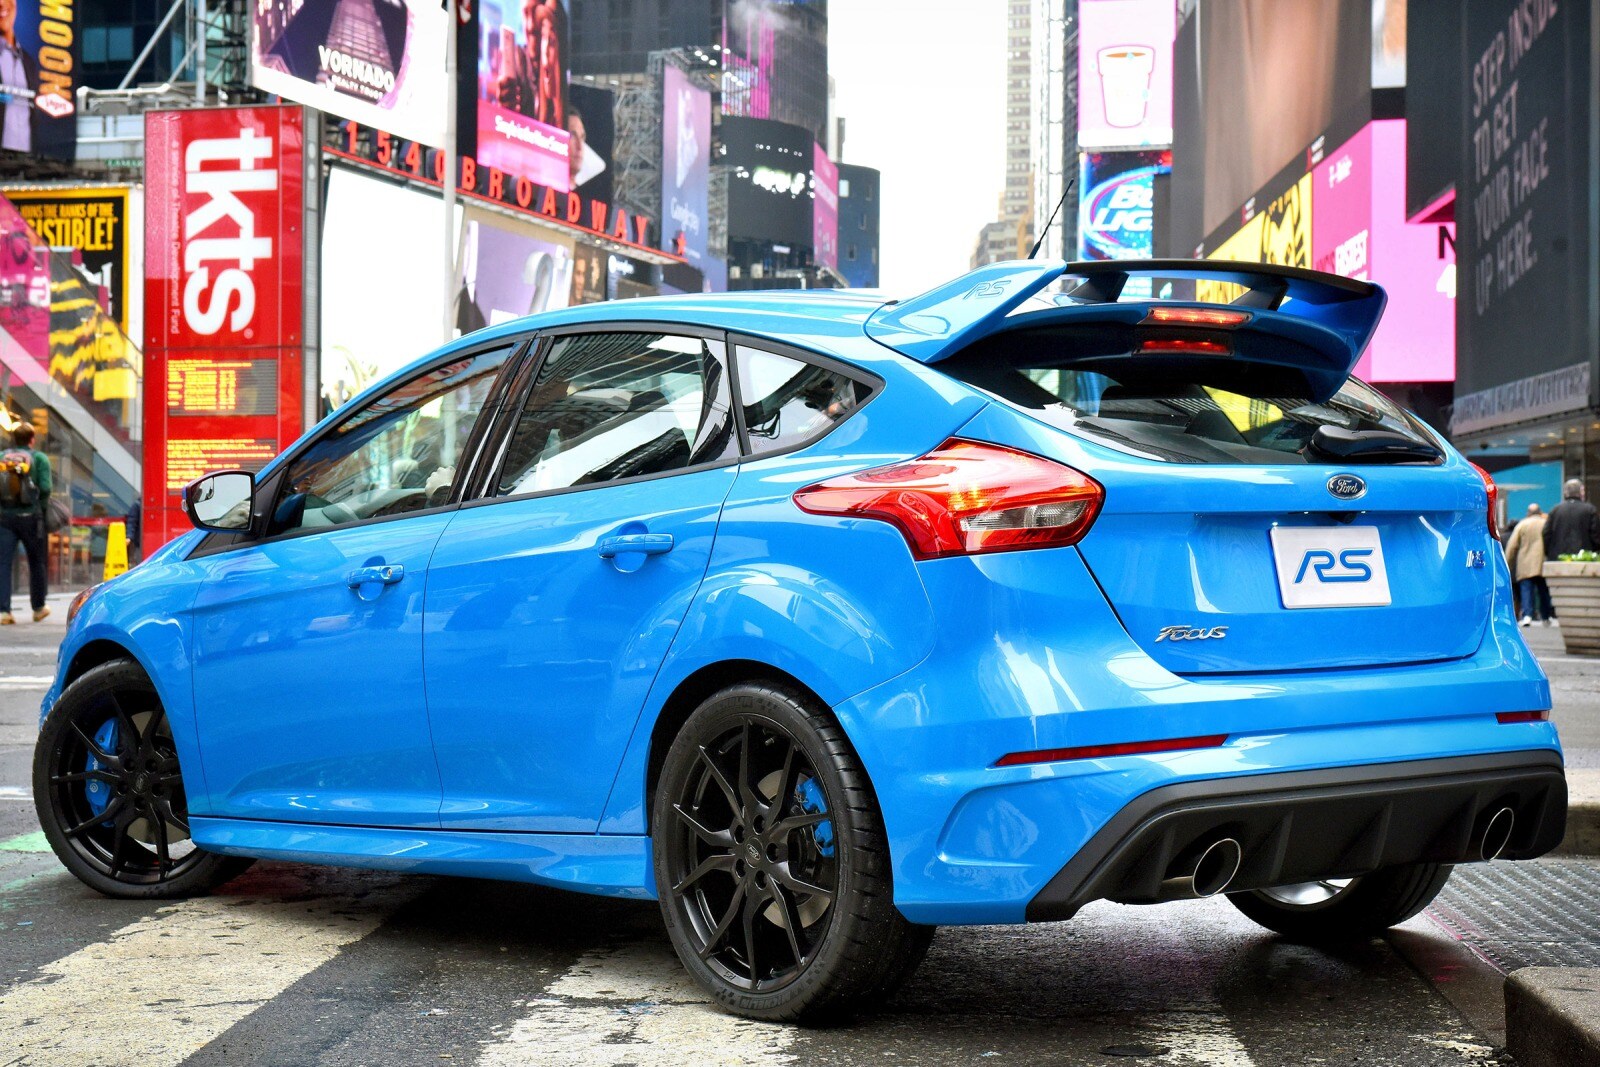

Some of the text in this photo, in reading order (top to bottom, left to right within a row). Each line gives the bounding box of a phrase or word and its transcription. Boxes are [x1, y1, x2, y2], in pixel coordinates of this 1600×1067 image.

[318, 44, 395, 93] VORNADO
[1473, 31, 1505, 118] STEP
[1474, 80, 1519, 183] TO GET
[461, 154, 649, 247] BROADWAY
[1474, 117, 1550, 248] YOUR FACE
[171, 202, 181, 239] Theatre
[184, 128, 279, 336] tkts
[169, 241, 181, 307] Development
[962, 280, 1011, 300] RS
[1476, 253, 1493, 317] UP
[1497, 209, 1539, 294] HERE.
[171, 309, 181, 334] Fund
[1335, 479, 1359, 494] Ford
[1294, 548, 1374, 583] RS
